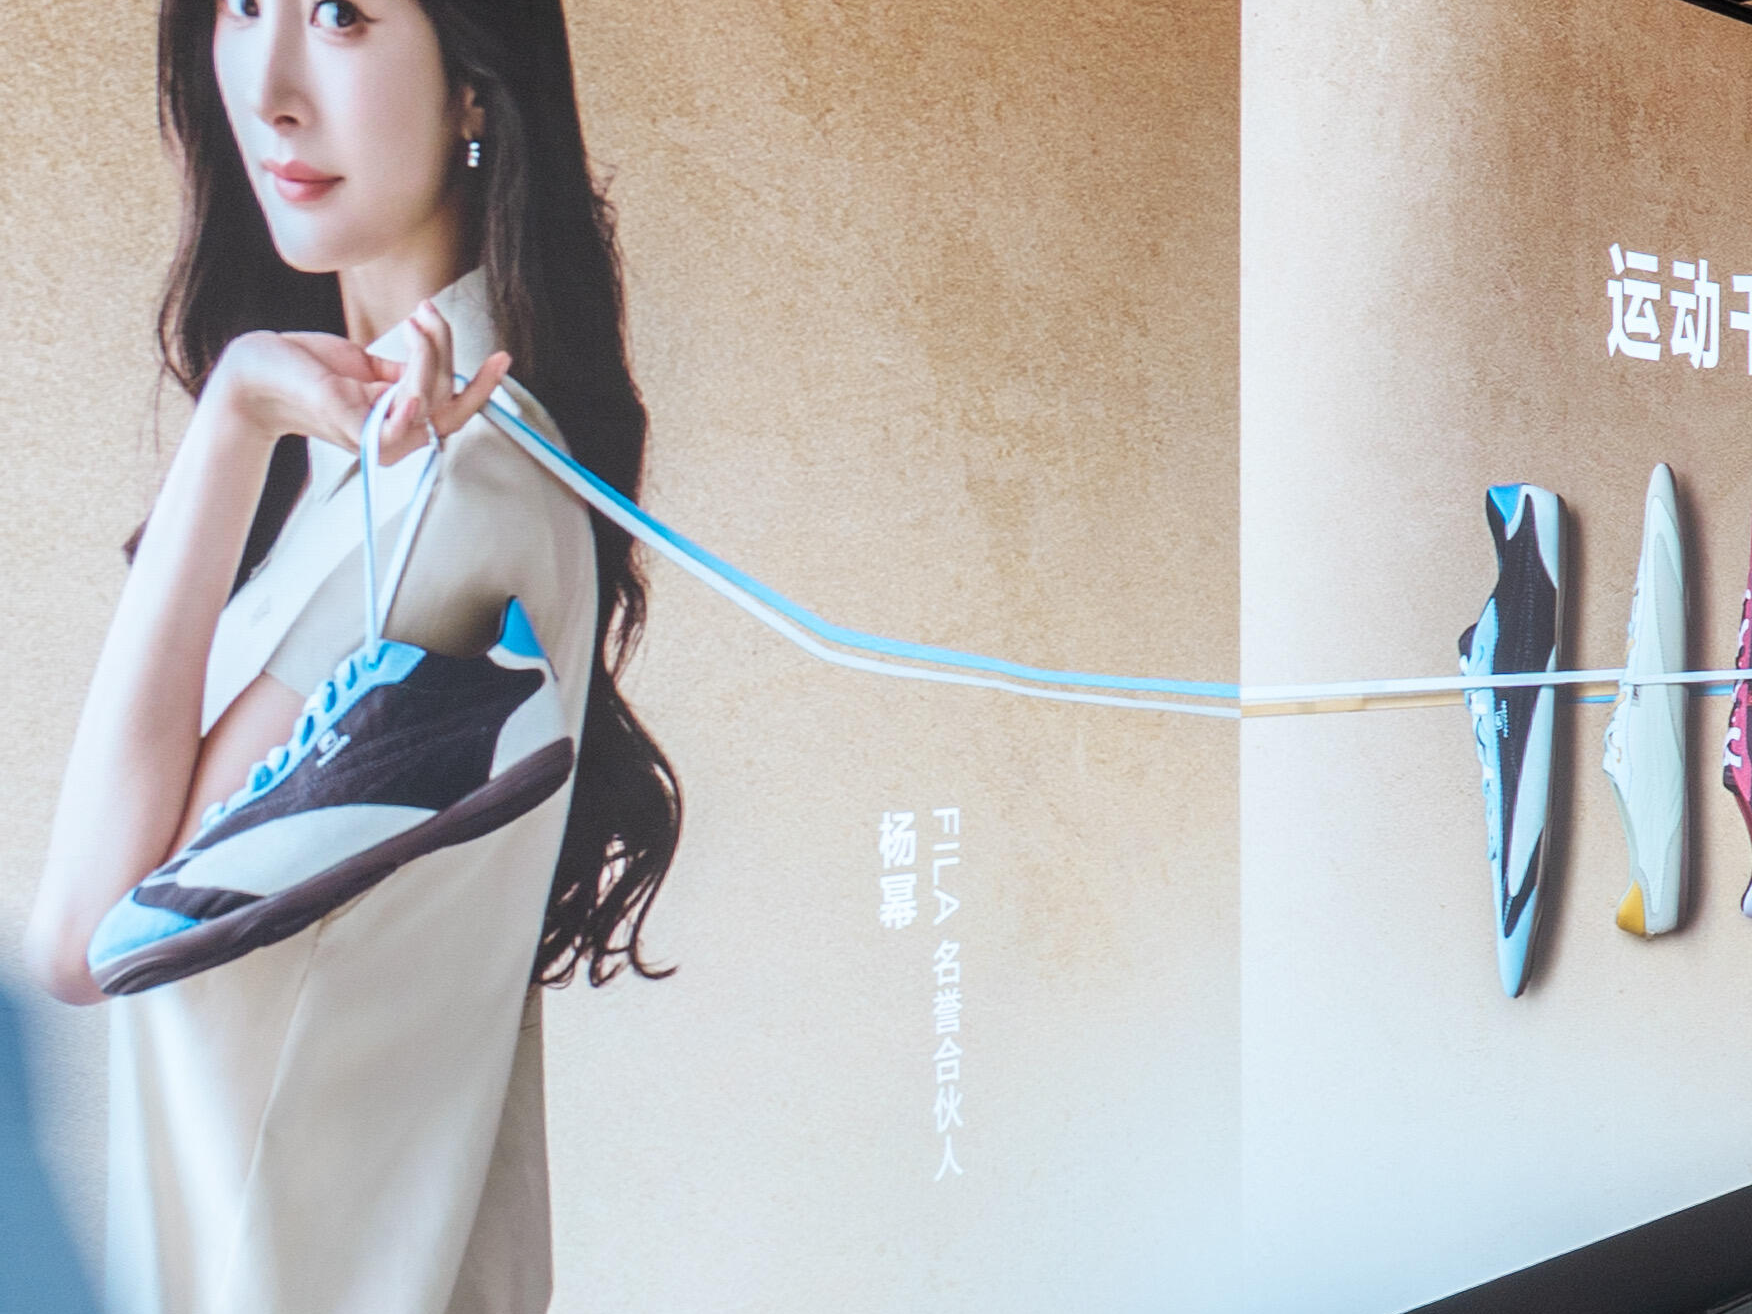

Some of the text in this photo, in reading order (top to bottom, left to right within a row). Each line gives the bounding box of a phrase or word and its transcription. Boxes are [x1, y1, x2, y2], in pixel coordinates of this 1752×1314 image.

[878, 811, 917, 930] 杨幂
[932, 807, 963, 1182] FILA 名誉合伙人
